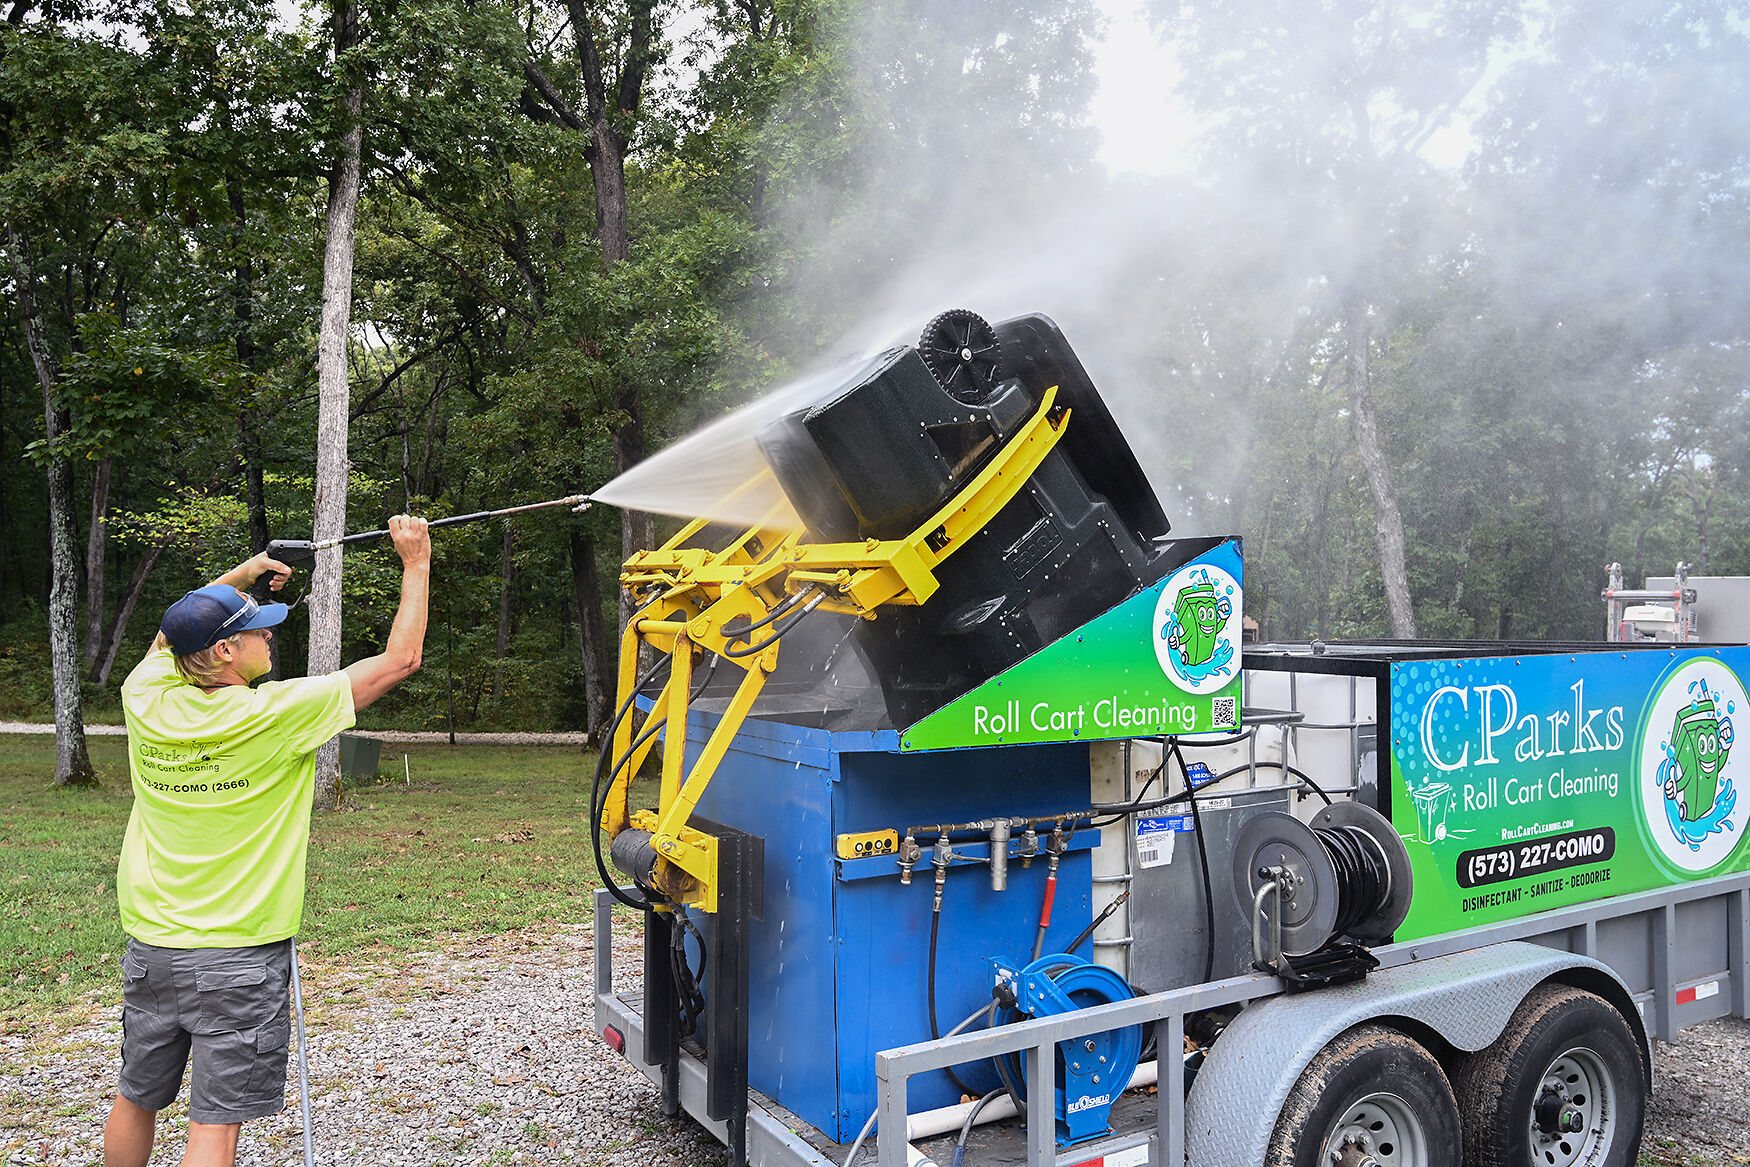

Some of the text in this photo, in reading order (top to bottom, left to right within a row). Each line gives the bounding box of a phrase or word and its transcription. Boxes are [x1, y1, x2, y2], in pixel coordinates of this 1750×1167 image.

[974, 696, 1196, 735] Roll Cart Cleaning
[1421, 678, 1624, 771] CParks
[139, 743, 188, 762] CParks
[157, 764, 176, 773] Cart
[178, 763, 220, 773] Cleaning
[212, 778, 250, 793] (2666)
[1464, 769, 1619, 812] Roll Cart Cleaning
[1468, 833, 1605, 884] (573) 227-COMO
[1462, 888, 1522, 913] DISINFECTANT
[1530, 878, 1564, 898] SANITIZE
[1571, 868, 1611, 889] DEODORIZE
